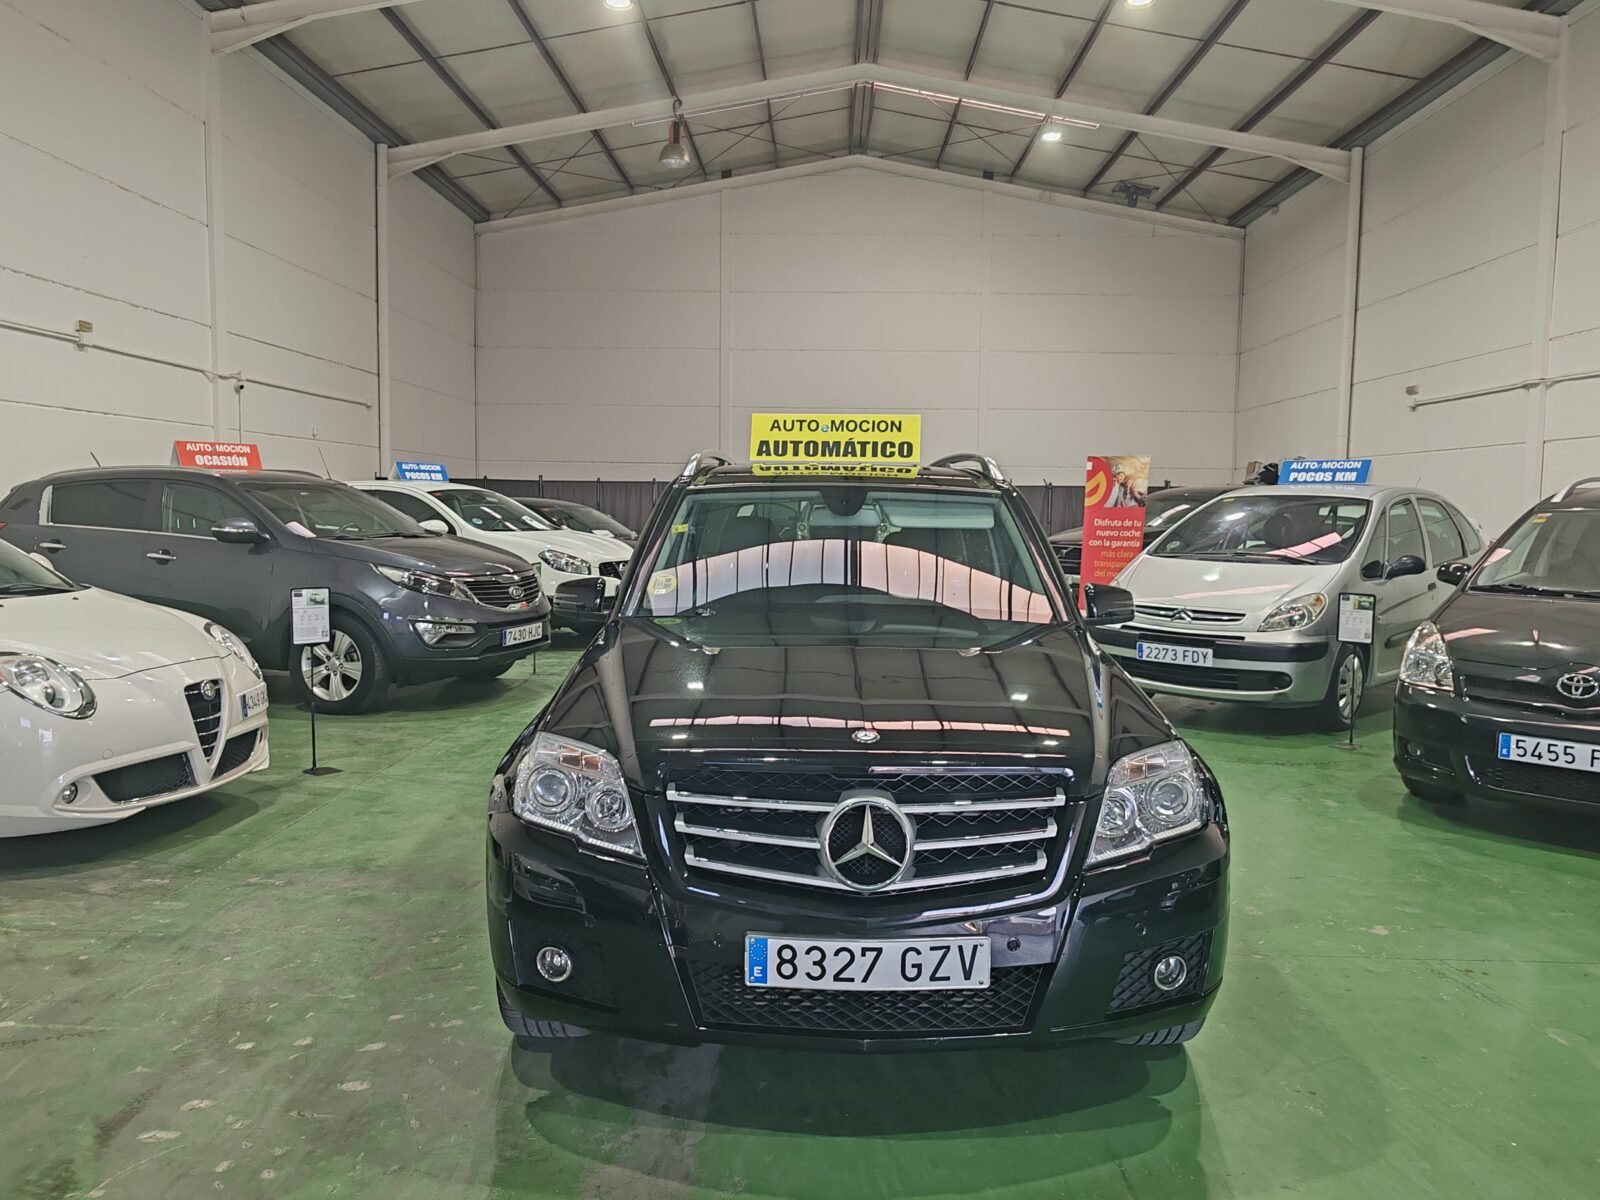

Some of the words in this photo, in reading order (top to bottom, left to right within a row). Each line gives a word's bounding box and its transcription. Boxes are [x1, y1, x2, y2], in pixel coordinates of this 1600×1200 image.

[770, 420, 820, 432] AUTO
[830, 420, 902, 432] MOCION
[186, 442, 212, 452] AUTO
[216, 444, 250, 454] MOCION
[756, 438, 913, 458] AUTOMÁTICO
[194, 454, 248, 466] OCASIÓN
[1290, 462, 1318, 470] AUTO
[1322, 461, 1362, 469] MOCION
[404, 472, 431, 480] POCOS
[431, 472, 444, 481] KM
[1288, 472, 1332, 482] POCOS
[1335, 472, 1358, 482] KM
[1094, 518, 1122, 526] Disfruta
[1104, 538, 1110, 546] la
[508, 628, 527, 643] 7430
[1146, 646, 1178, 661] 2273
[1183, 650, 1208, 664] FDY
[1516, 740, 1576, 764] 5455
[754, 966, 762, 977] E
[776, 944, 884, 983] 8327
[900, 944, 978, 982] GZV
